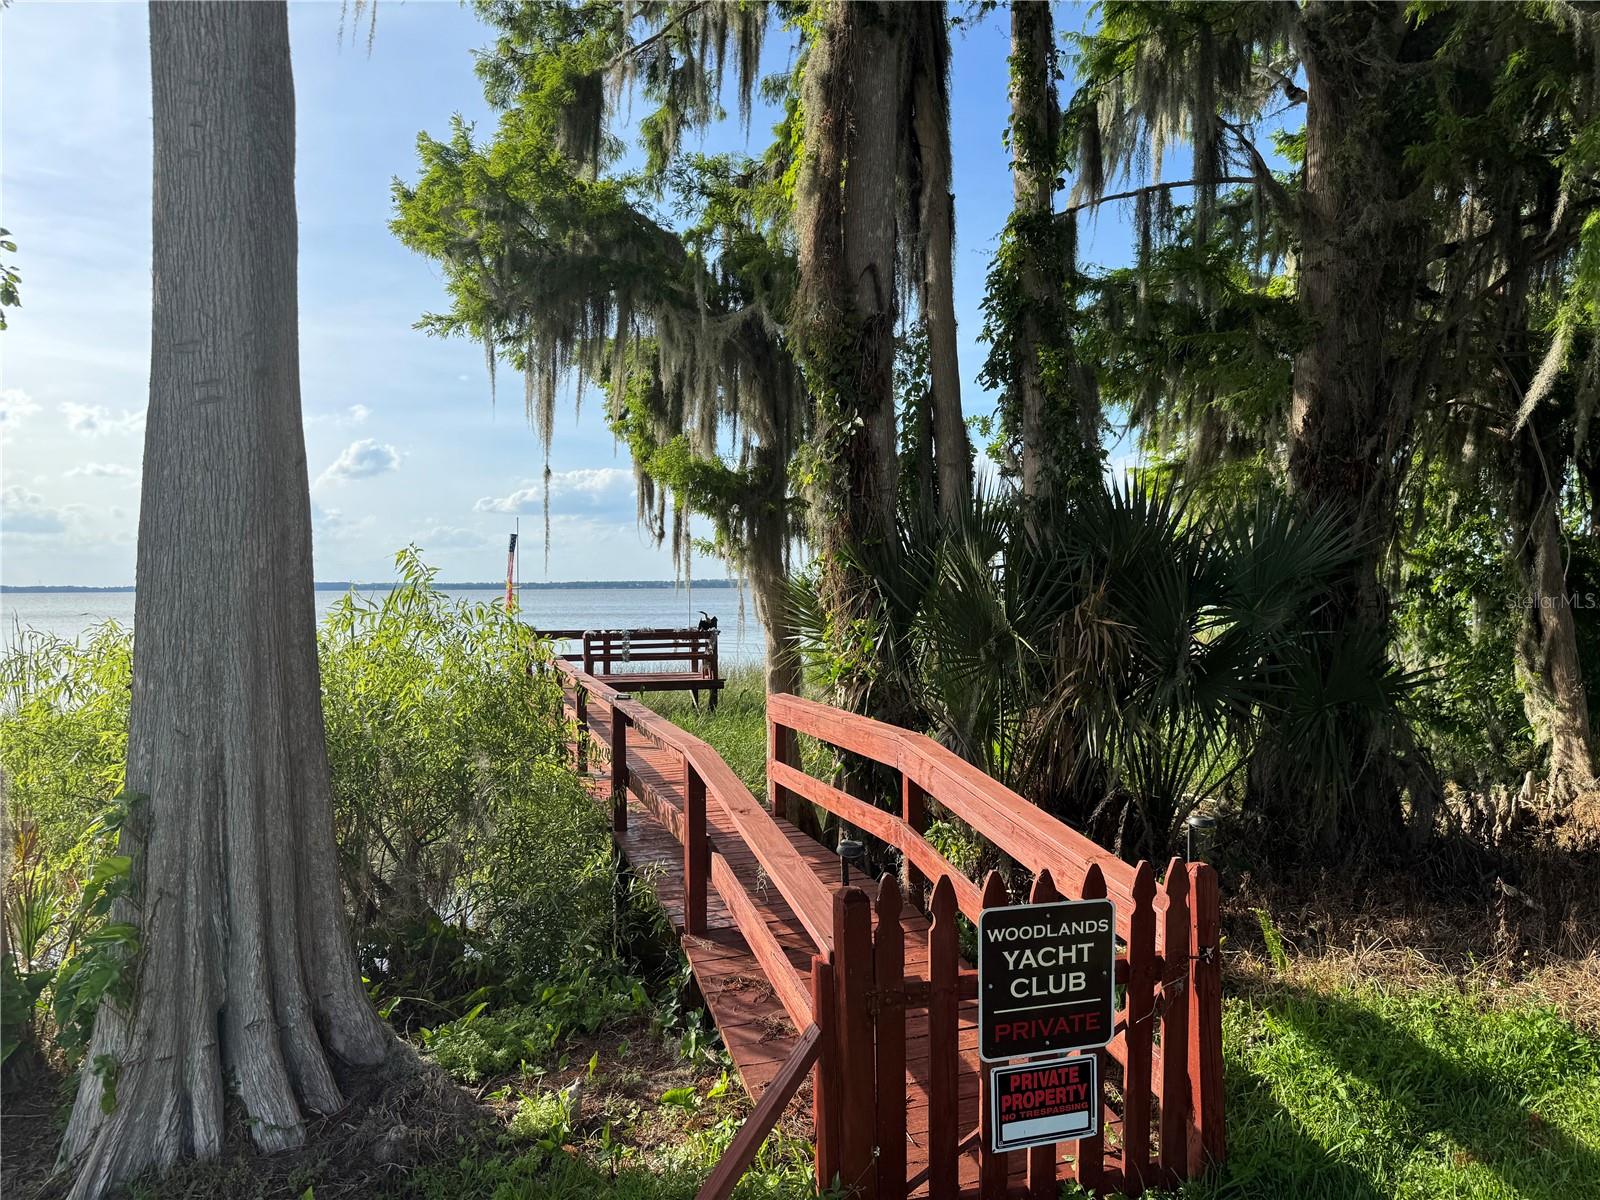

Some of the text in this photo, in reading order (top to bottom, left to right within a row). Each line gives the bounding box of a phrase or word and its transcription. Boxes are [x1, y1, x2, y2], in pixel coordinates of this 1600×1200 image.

[987, 919, 1109, 942] WOODLANDS
[1002, 943, 1094, 970] YACHT
[1010, 972, 1086, 998] CLUB
[994, 1012, 1100, 1043] PRIVATE
[1010, 1066, 1080, 1092] PRIVATE
[1001, 1083, 1088, 1112] PROPERTY
[1002, 1102, 1088, 1122] NO TRESPASSING
